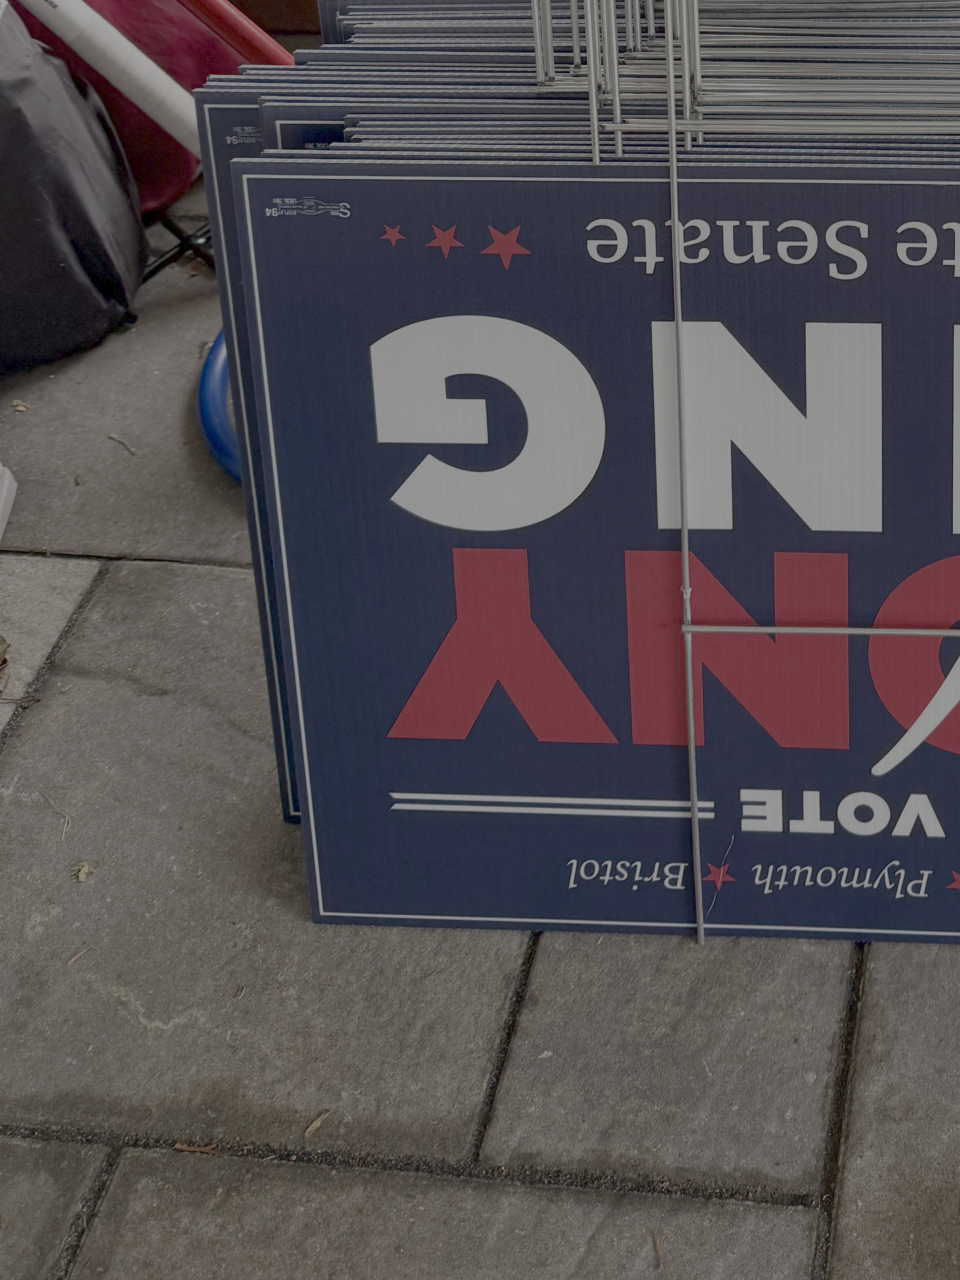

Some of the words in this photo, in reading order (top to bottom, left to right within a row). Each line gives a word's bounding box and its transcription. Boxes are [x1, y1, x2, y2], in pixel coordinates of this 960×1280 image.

[265, 207, 279, 217] 94
[585, 218, 870, 282] Senate
[739, 788, 946, 839] VOTE
[566, 857, 688, 892] Bristol
[751, 862, 933, 900] Plymouth
